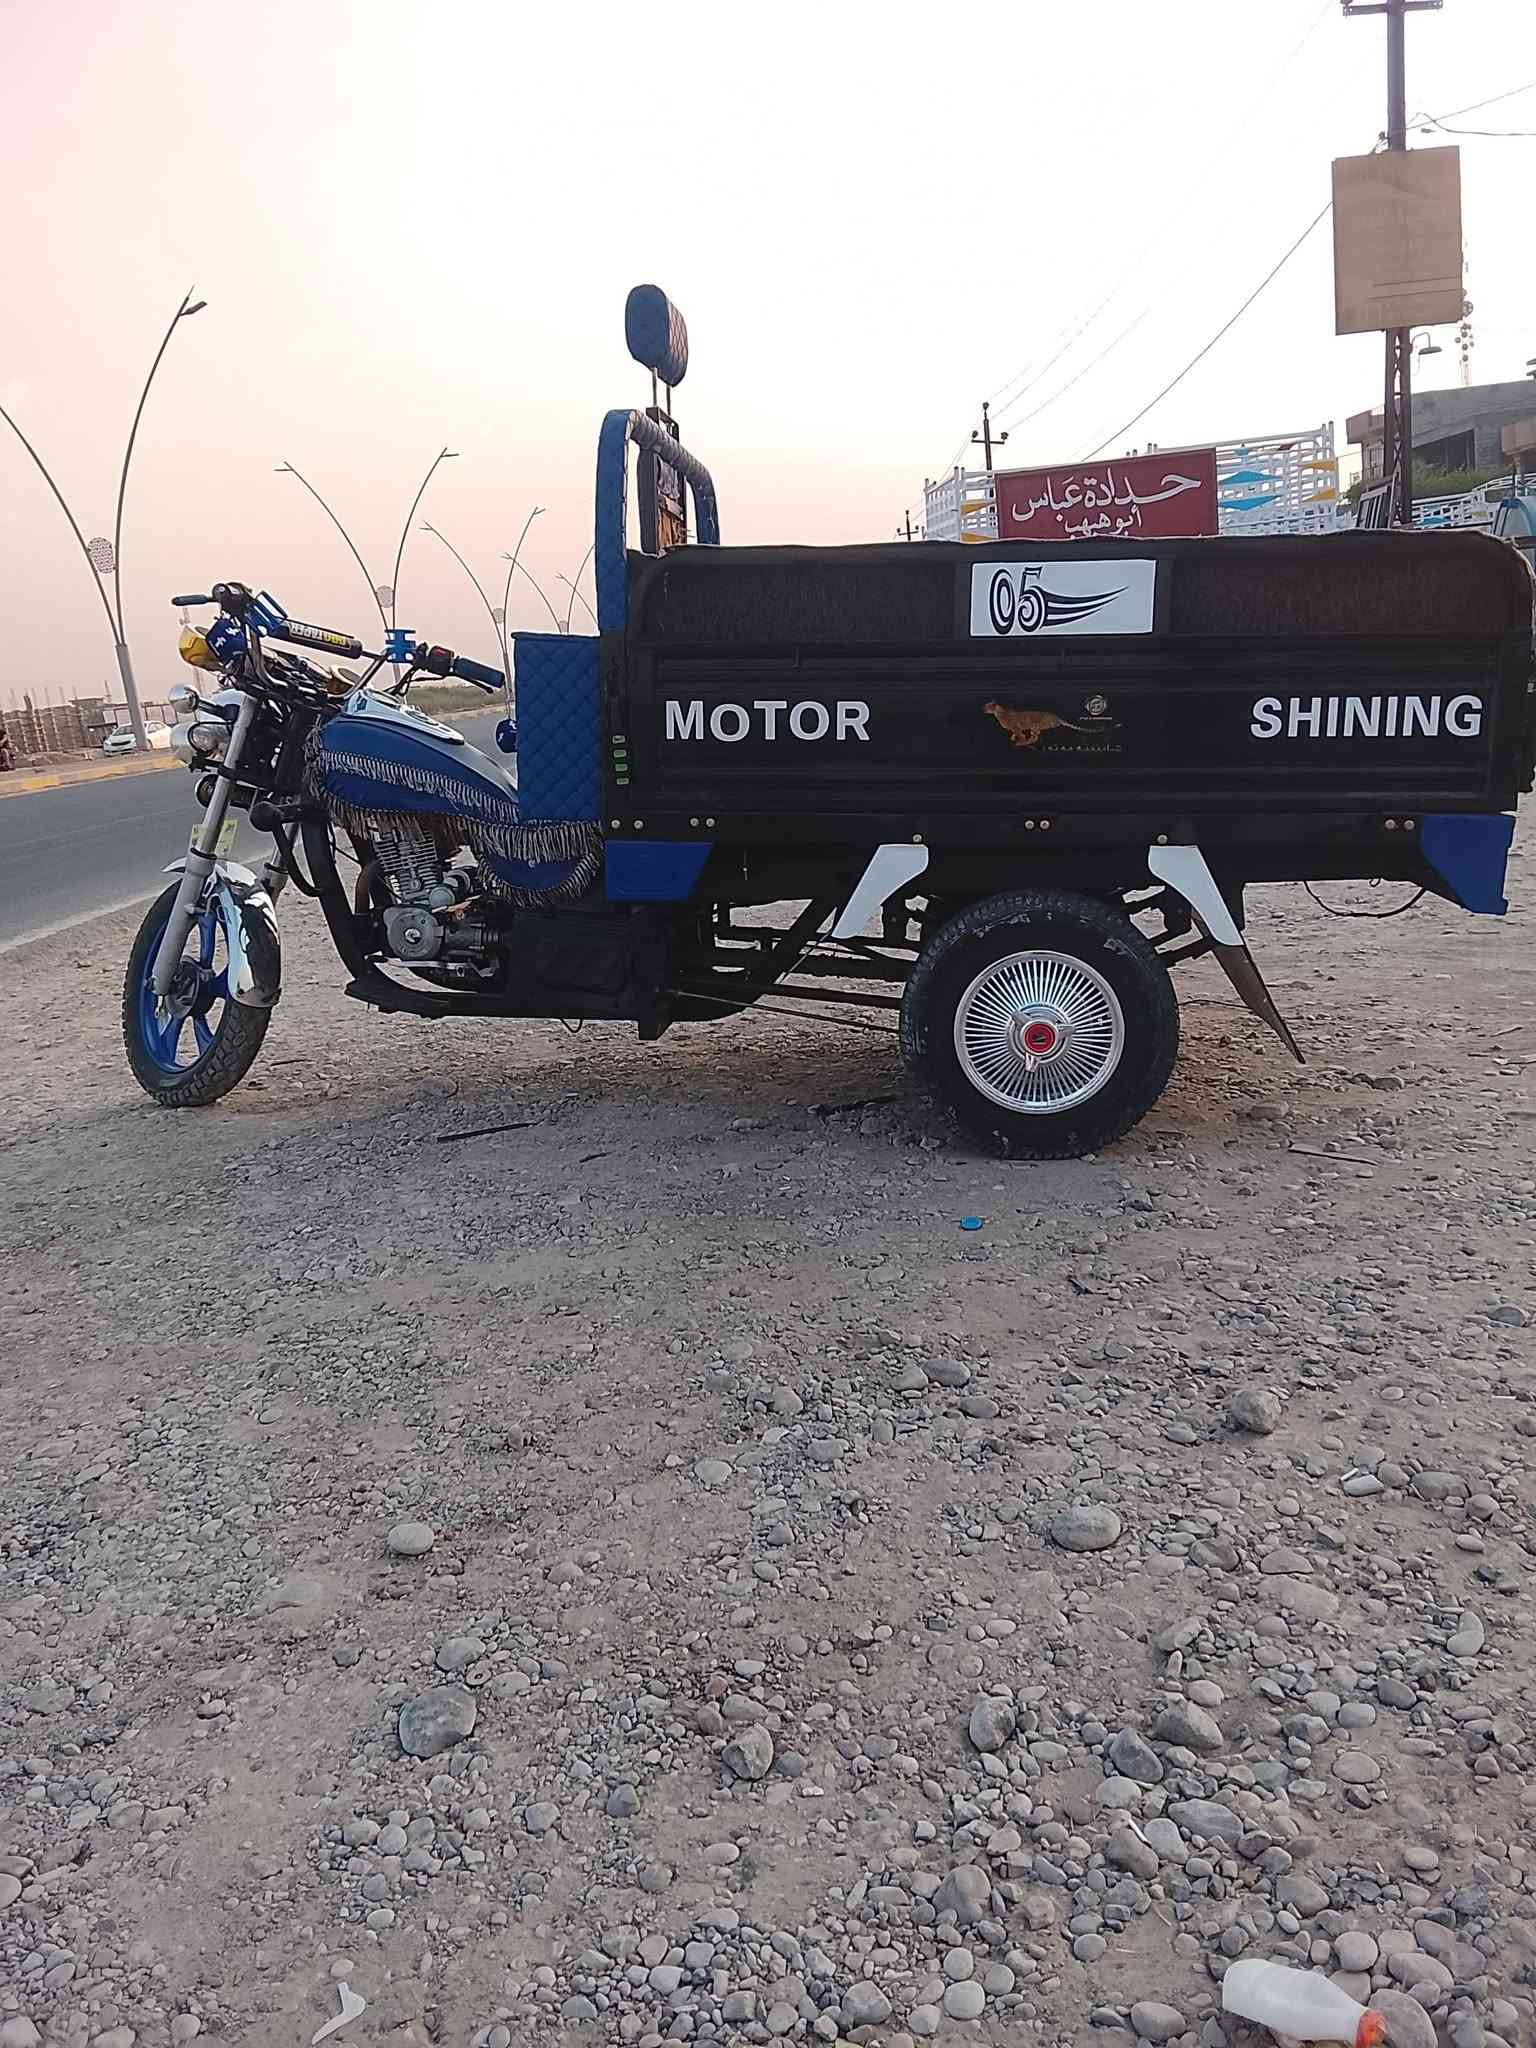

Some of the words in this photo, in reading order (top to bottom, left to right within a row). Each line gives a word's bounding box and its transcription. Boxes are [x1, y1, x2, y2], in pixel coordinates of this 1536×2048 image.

[1083, 467, 1201, 508] حدادة
[989, 566, 1046, 635] 05
[665, 700, 870, 742] MOTOR
[1250, 694, 1483, 738] SHINING
